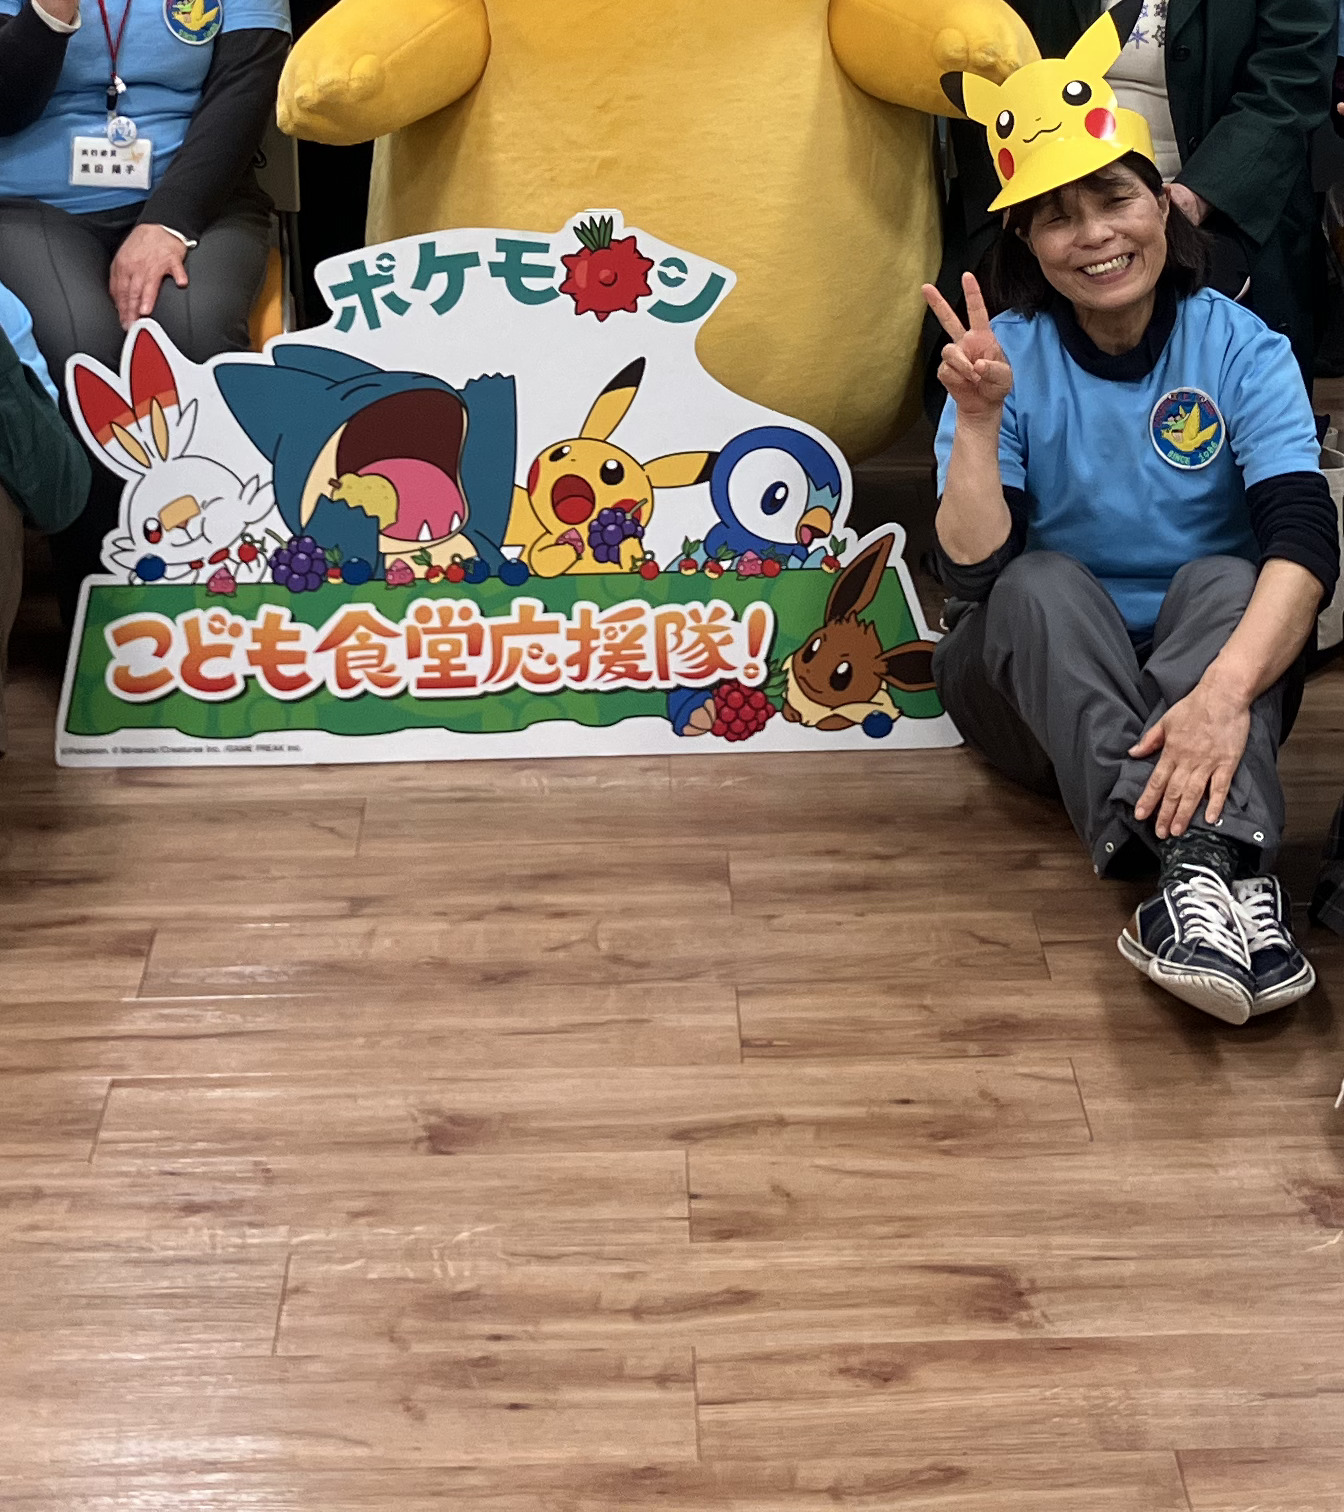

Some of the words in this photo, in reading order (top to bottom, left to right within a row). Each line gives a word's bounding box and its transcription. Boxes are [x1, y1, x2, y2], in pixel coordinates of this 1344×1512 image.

[328, 237, 727, 334] ポケモン
[112, 604, 766, 692] こども食堂応援隊！
